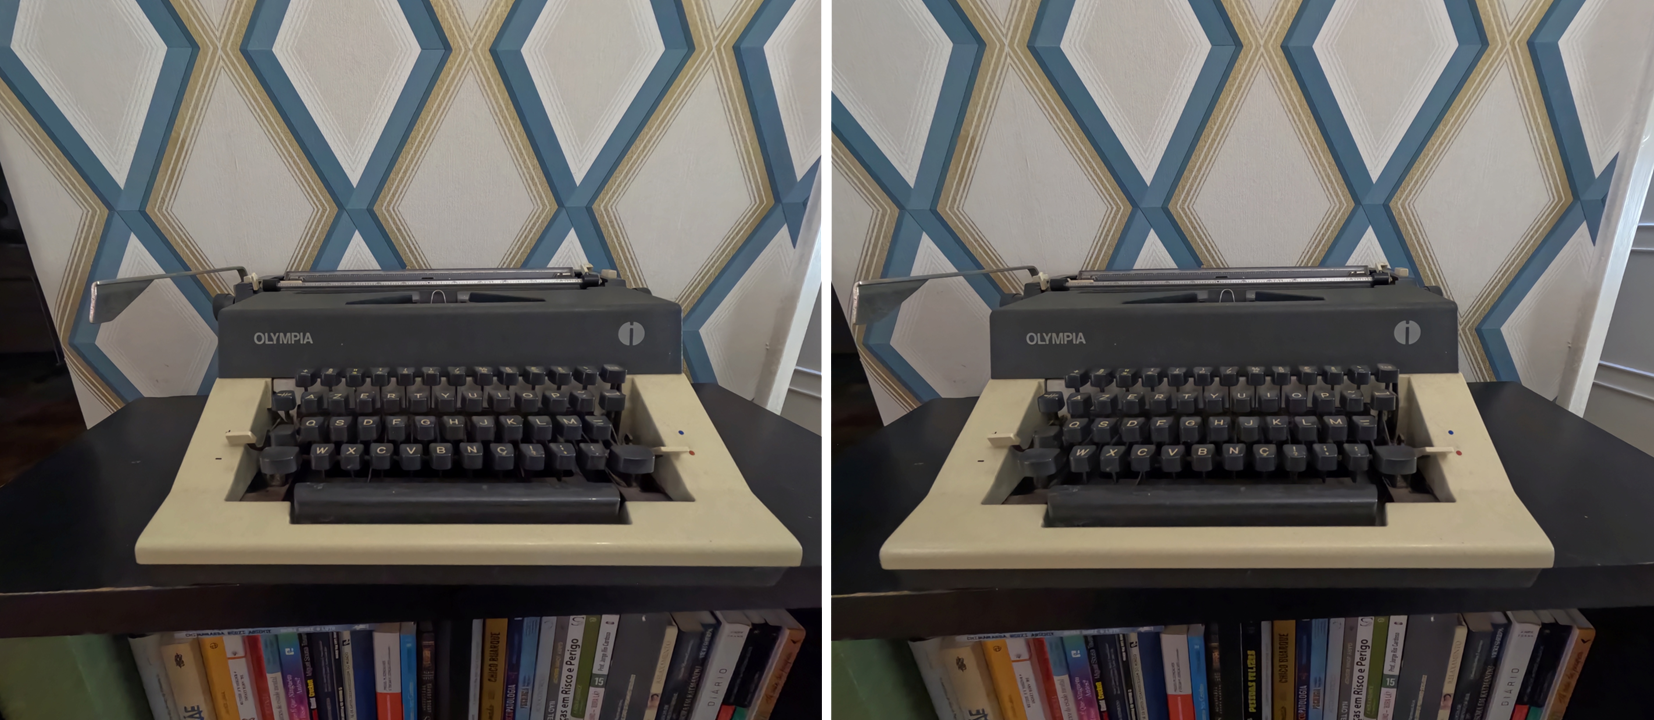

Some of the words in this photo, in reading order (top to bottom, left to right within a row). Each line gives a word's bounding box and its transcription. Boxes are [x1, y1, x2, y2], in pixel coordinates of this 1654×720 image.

[253, 332, 313, 345] OLYMPIA
[1026, 332, 1086, 345] OLYMPIA
[489, 632, 501, 661] BUARQUE
[566, 638, 581, 666] Perigo
[1278, 633, 1290, 661] BUARQUE
[1357, 639, 1370, 665] Perigo
[487, 662, 498, 683] CHICO
[594, 677, 604, 686] 15
[1278, 661, 1289, 684] CHICO
[1385, 677, 1396, 687] 15
[561, 674, 574, 695] Risco
[707, 668, 728, 707] DIÁRIO
[1355, 673, 1365, 695] Risco
[1501, 667, 1519, 706] DIÁRIO
[561, 696, 570, 709] em
[1354, 695, 1364, 707] em
